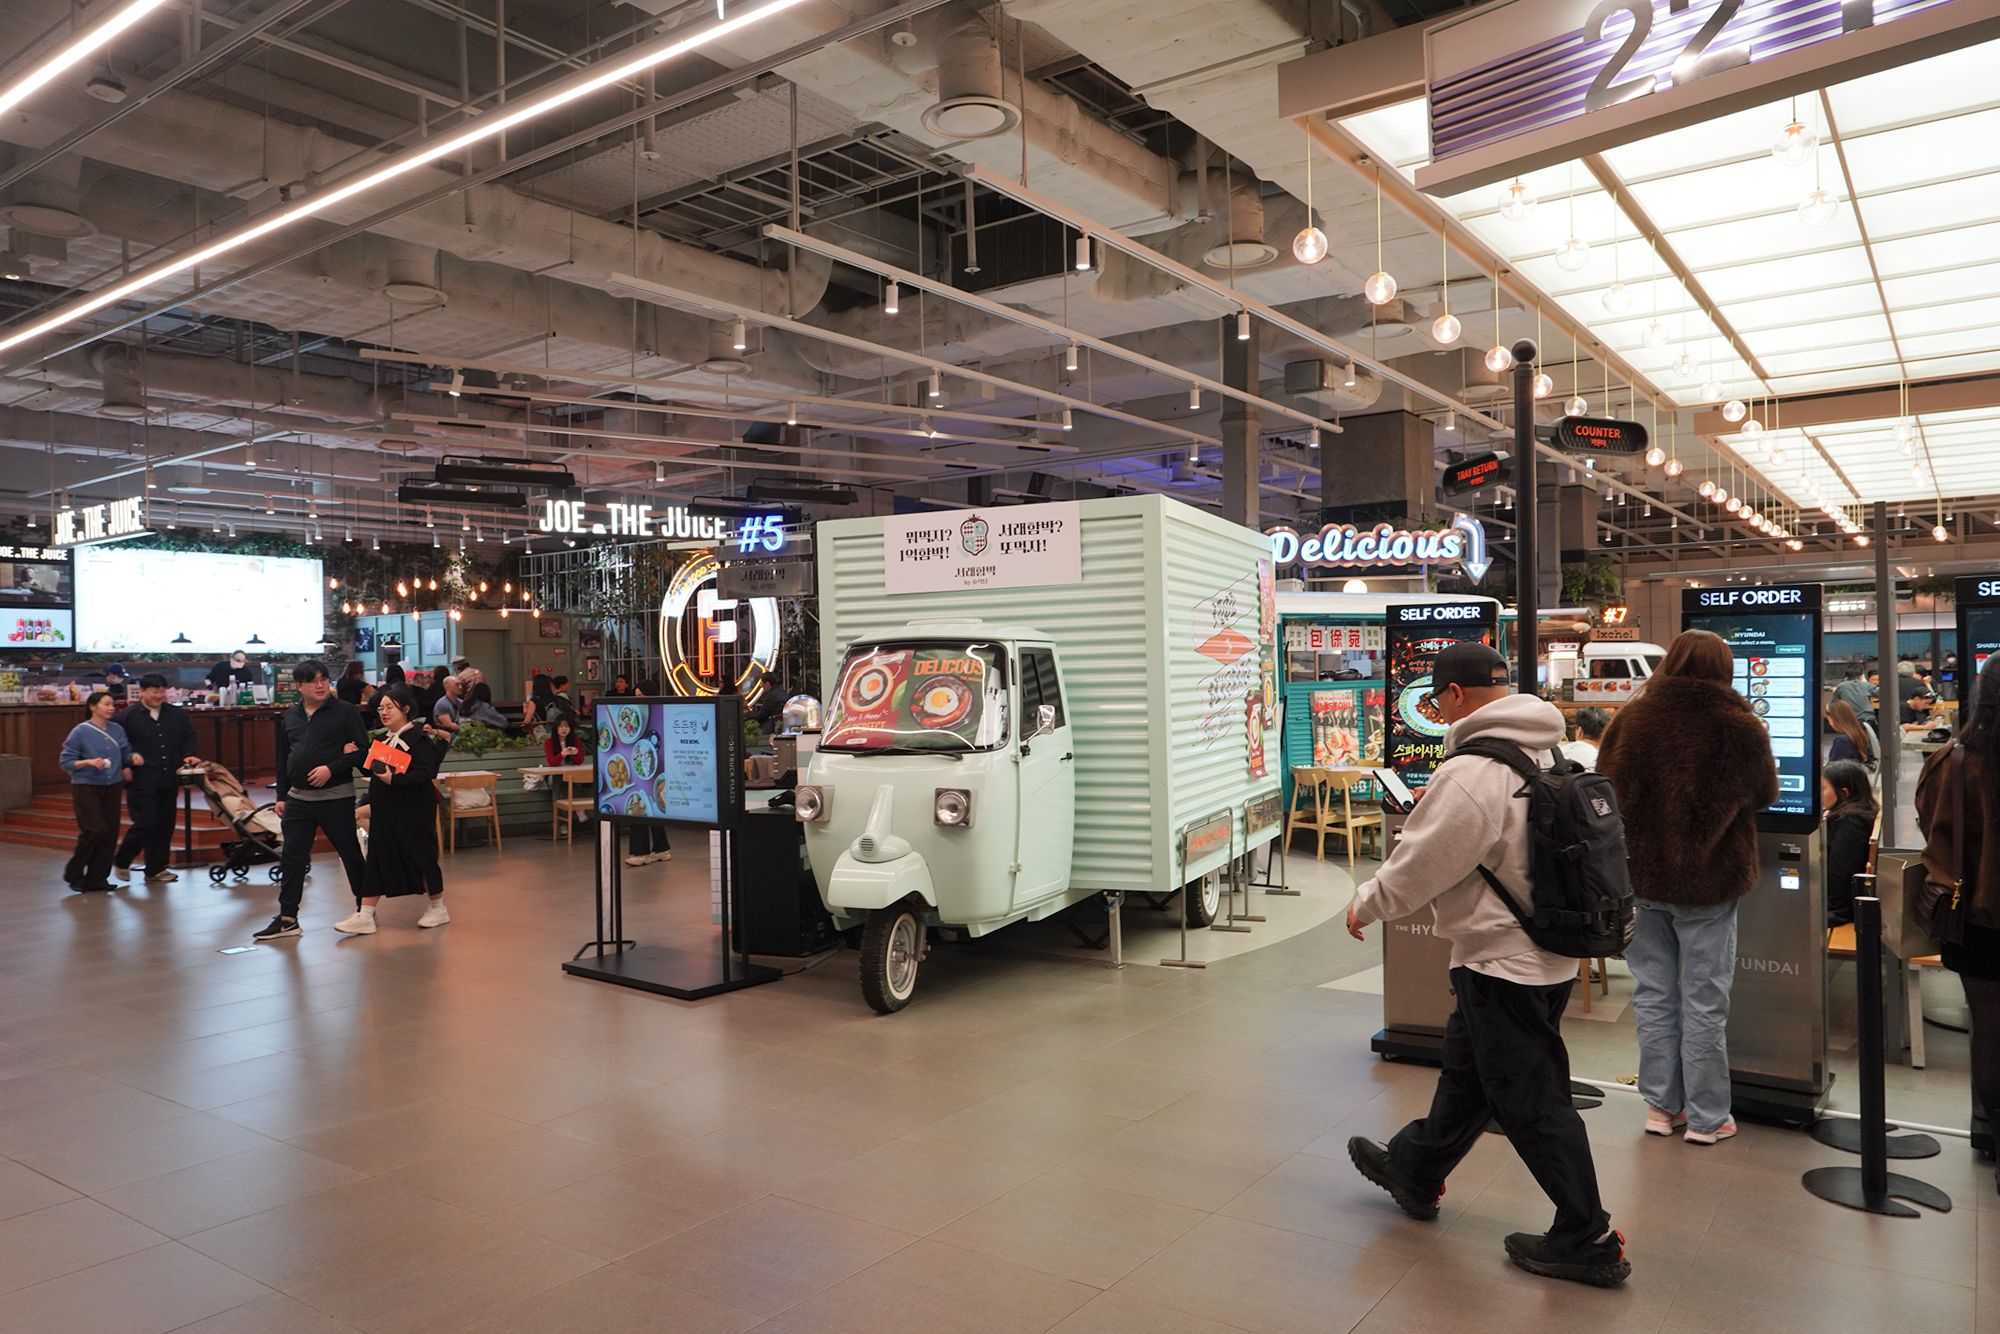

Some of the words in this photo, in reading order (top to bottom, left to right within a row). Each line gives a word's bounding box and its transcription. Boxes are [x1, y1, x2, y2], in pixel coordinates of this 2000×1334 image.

[1575, 425, 1621, 439] COUNTER
[1456, 468, 1474, 481] TRAY
[1473, 460, 1499, 476] RETURN
[55, 510, 76, 545] JOE
[82, 504, 107, 540] THE
[108, 495, 144, 536] JUICE
[539, 499, 587, 533] JOE
[606, 503, 653, 536] THE
[661, 506, 727, 540] JUICE
[737, 515, 784, 553] #5
[998, 520, 1063, 537] 서래함박?
[20, 547, 39, 559] THE
[40, 549, 68, 560] JUICE
[1271, 528, 1462, 563] Delicious
[1700, 592, 1739, 606] SELF
[1741, 589, 1802, 605] ORDER
[1400, 608, 1432, 621] SELF
[1433, 606, 1481, 620] ORDER
[1603, 607, 1627, 623] #7
[1596, 629, 1634, 640] Ixchel
[1736, 957, 1799, 975] UNDAI
